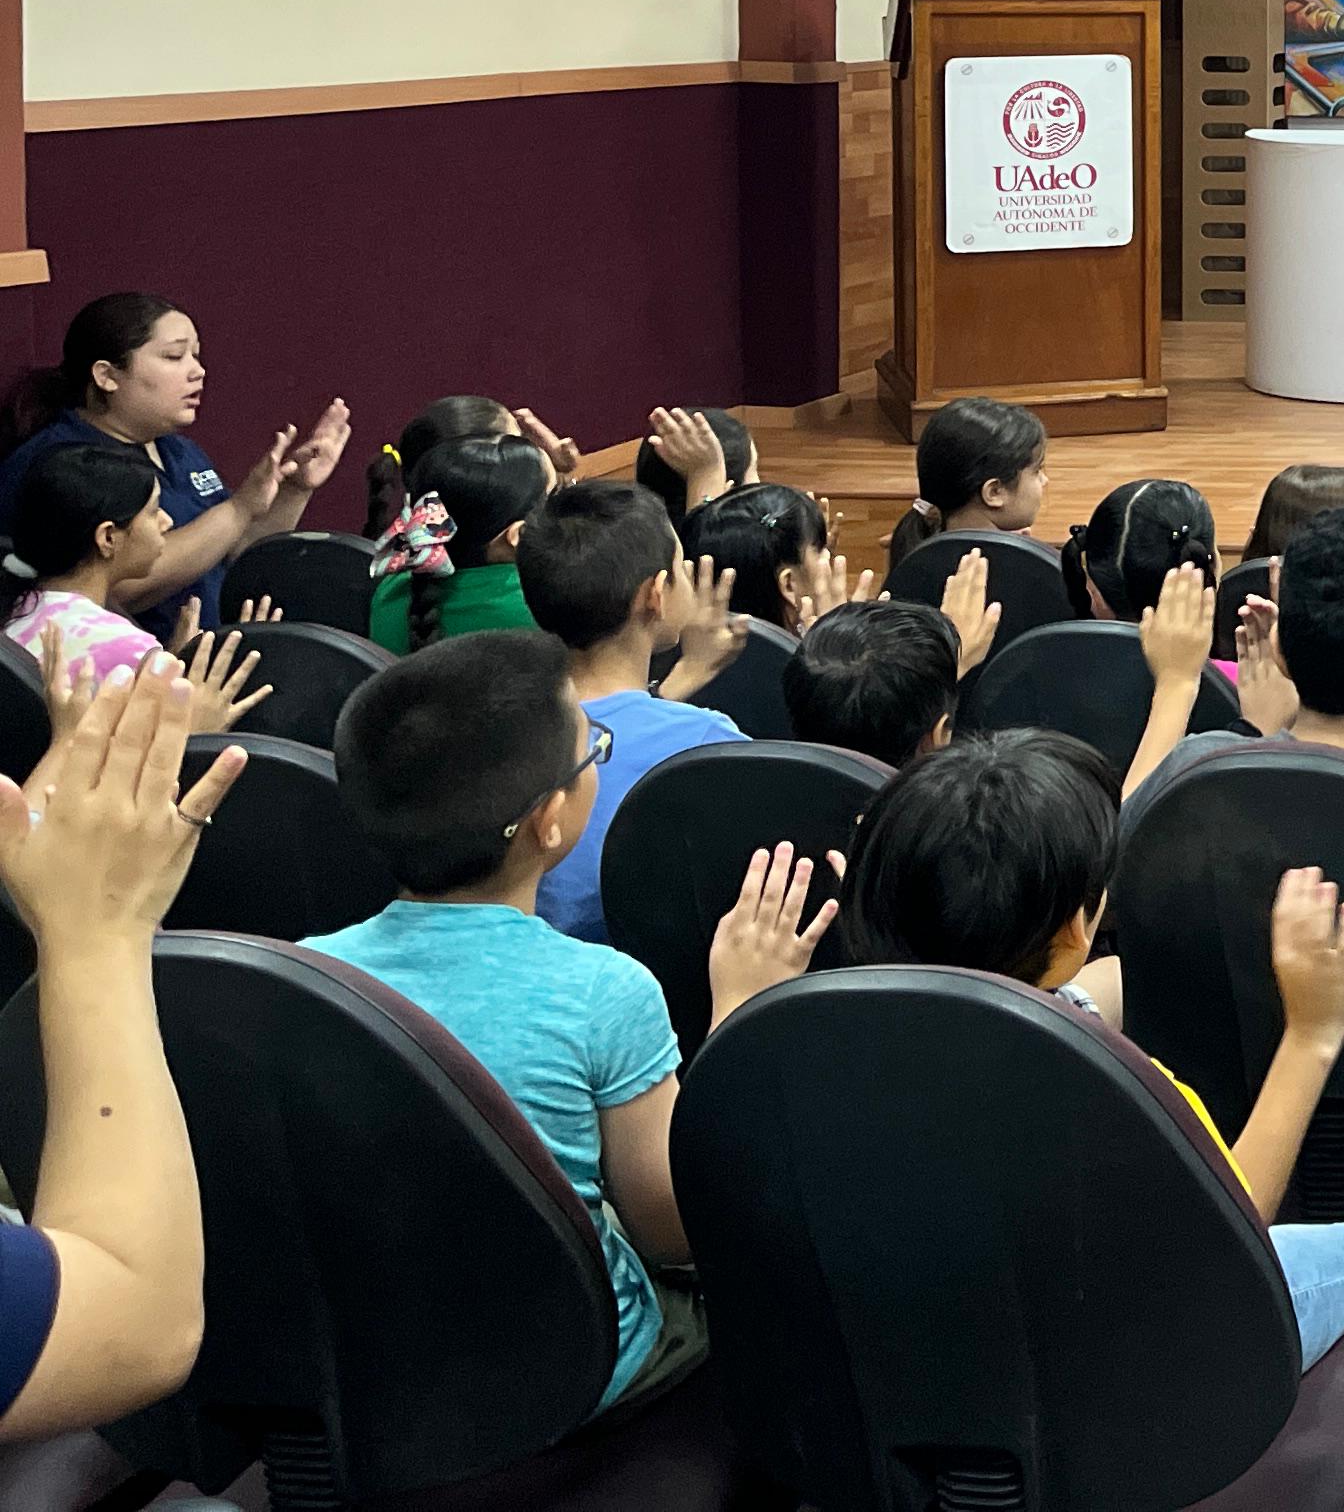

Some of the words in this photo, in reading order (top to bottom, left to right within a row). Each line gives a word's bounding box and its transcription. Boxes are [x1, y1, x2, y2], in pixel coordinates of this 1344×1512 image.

[992, 163, 1097, 192] UAdeO
[999, 193, 1092, 207] UNIVERSIDAD
[1080, 206, 1098, 218] DE
[1005, 220, 1085, 234] OCCIDENTE
